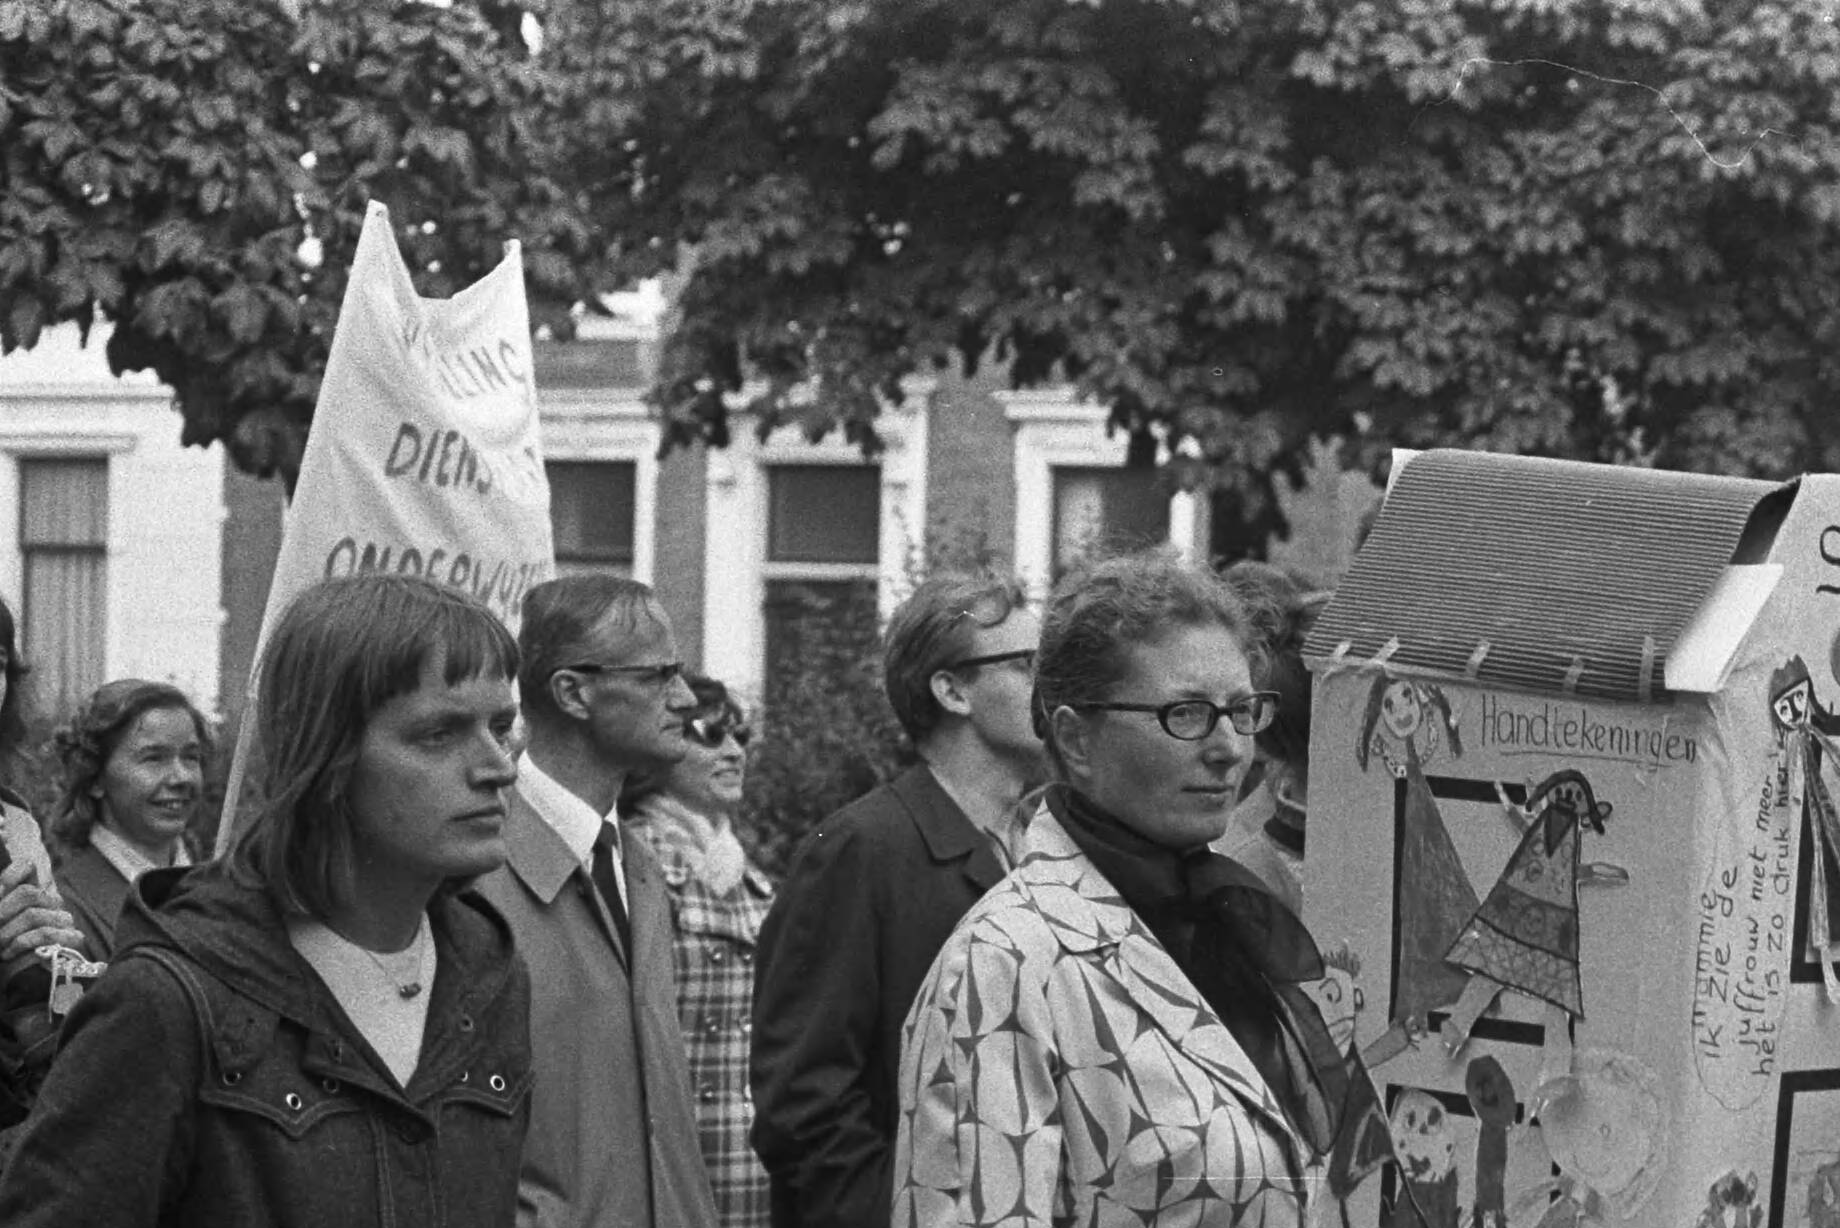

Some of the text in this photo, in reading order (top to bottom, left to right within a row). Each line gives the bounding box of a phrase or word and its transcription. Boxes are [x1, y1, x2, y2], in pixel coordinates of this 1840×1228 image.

[1482, 693, 1697, 773] Handtekeningen
[1715, 866, 1738, 917] de
[1732, 775, 1773, 1055] juffrouw niet meer
[1751, 1021, 1776, 1076] het
[1764, 969, 1779, 996] is
[1773, 827, 1790, 895] druk
